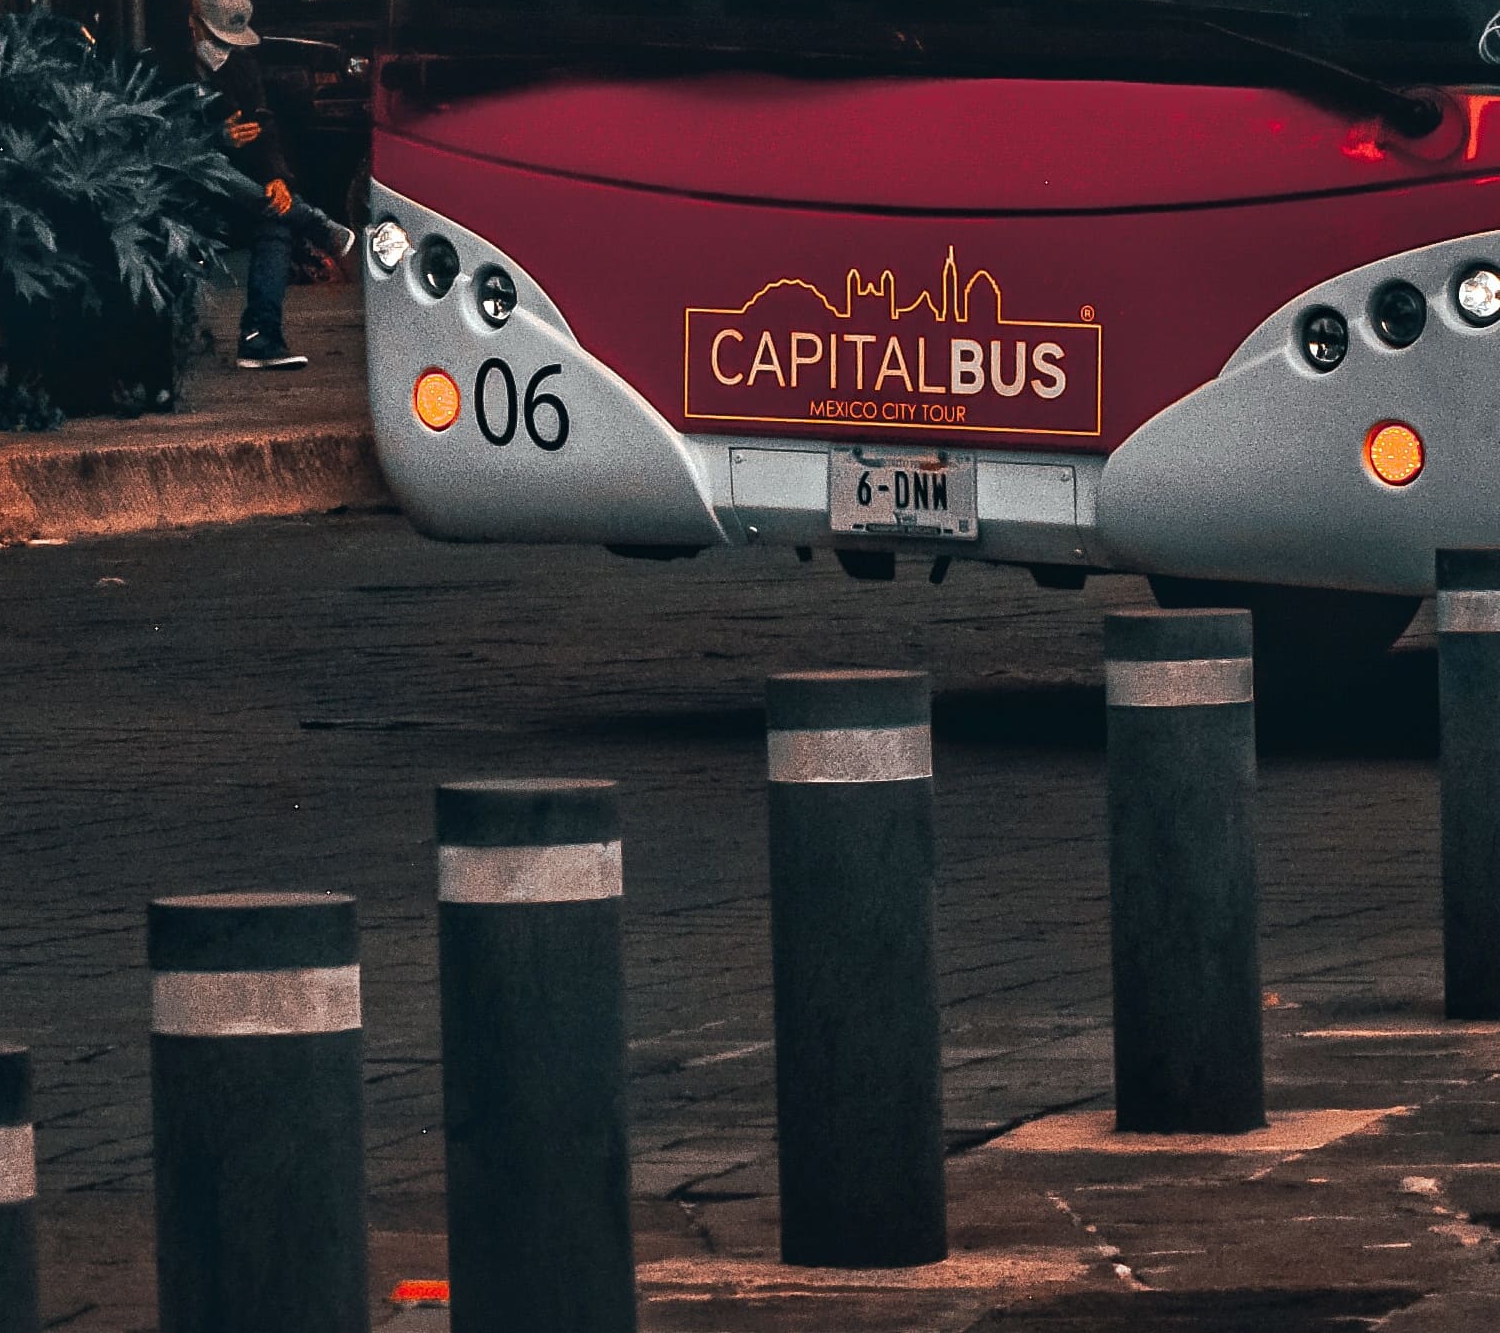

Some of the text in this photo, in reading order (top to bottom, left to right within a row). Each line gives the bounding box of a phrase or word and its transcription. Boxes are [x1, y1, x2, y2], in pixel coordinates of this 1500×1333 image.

[710, 328, 1067, 399] CAPITALBUS
[474, 357, 570, 451] 06
[810, 400, 966, 423] MEXICO CITY TOUR
[857, 470, 948, 511] 6-DNW
